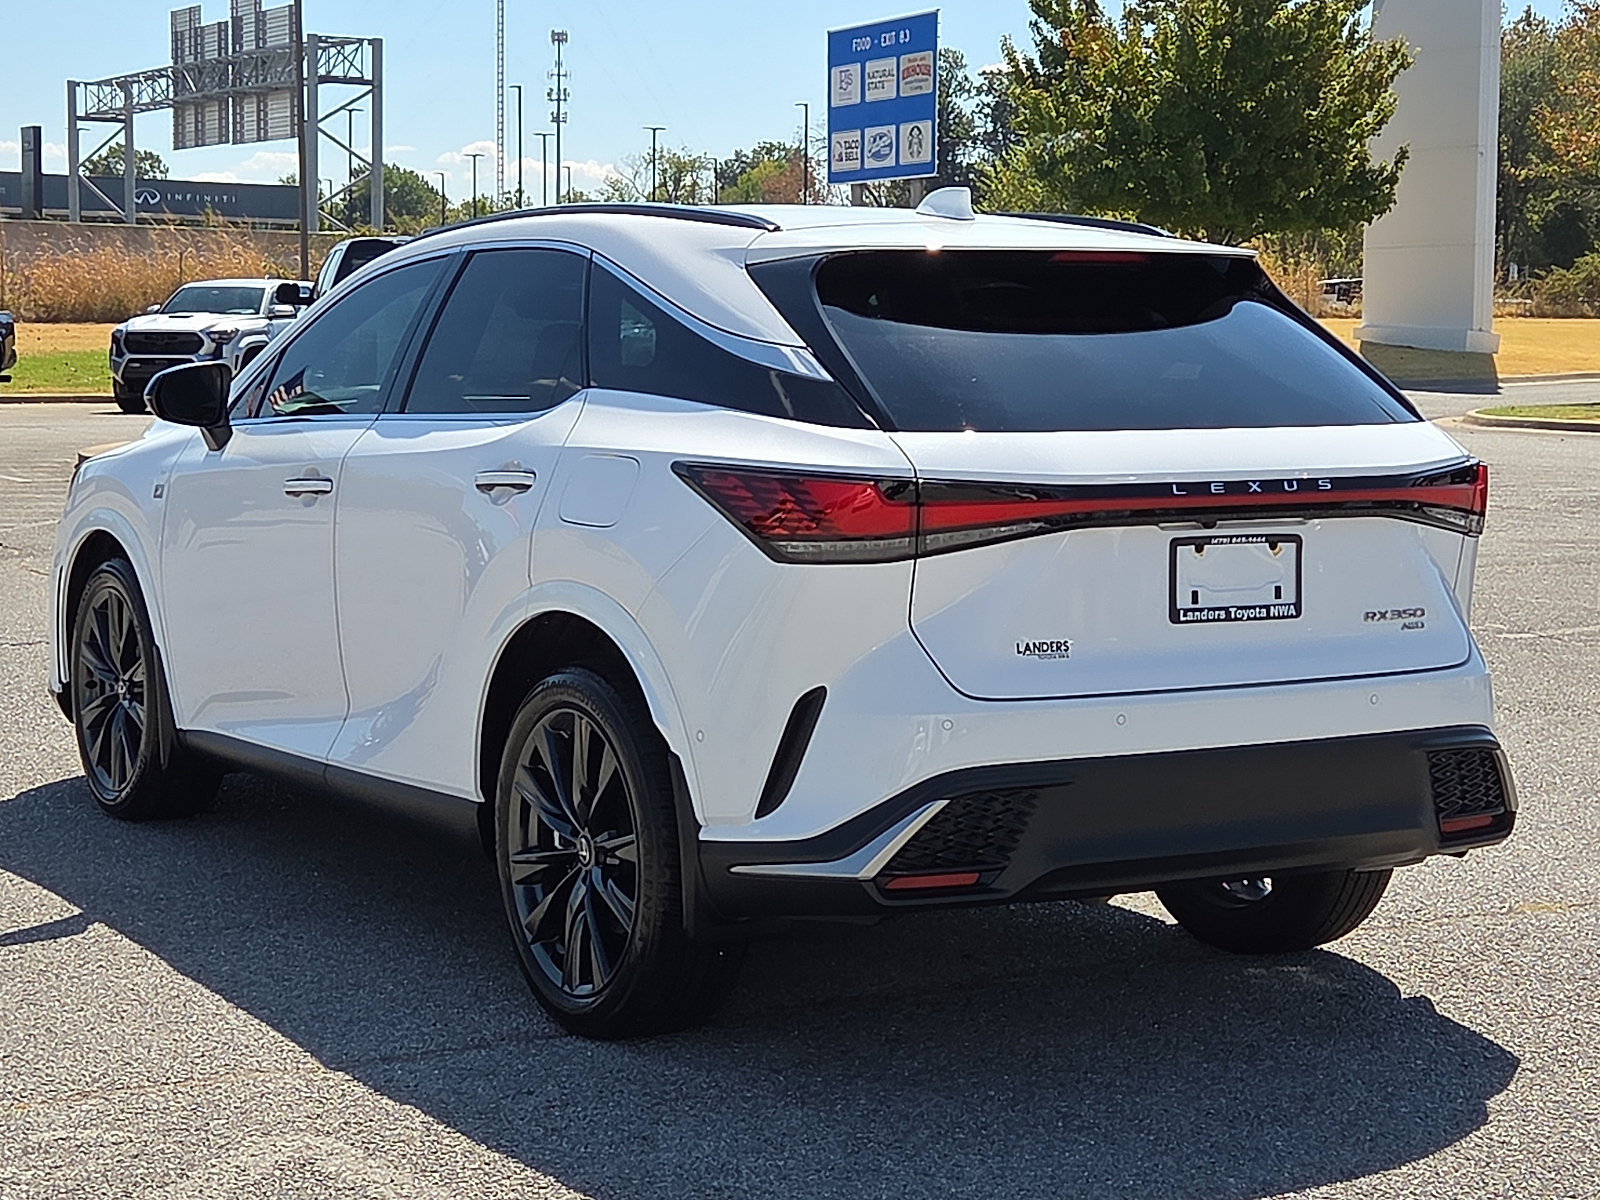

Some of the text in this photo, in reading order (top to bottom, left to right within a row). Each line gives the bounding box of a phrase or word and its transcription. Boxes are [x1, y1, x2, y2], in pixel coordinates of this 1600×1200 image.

[852, 36, 871, 52] FOOD
[881, 31, 896, 47] EXIT
[867, 68, 895, 80] NATURAL
[843, 139, 859, 150] TACO
[844, 151, 859, 162] BELL
[166, 193, 236, 203] INFINITI
[1172, 479, 1332, 495] LEXUS
[1180, 605, 1296, 621] Landers Toyota NWA
[1016, 640, 1070, 656] LANDERS
